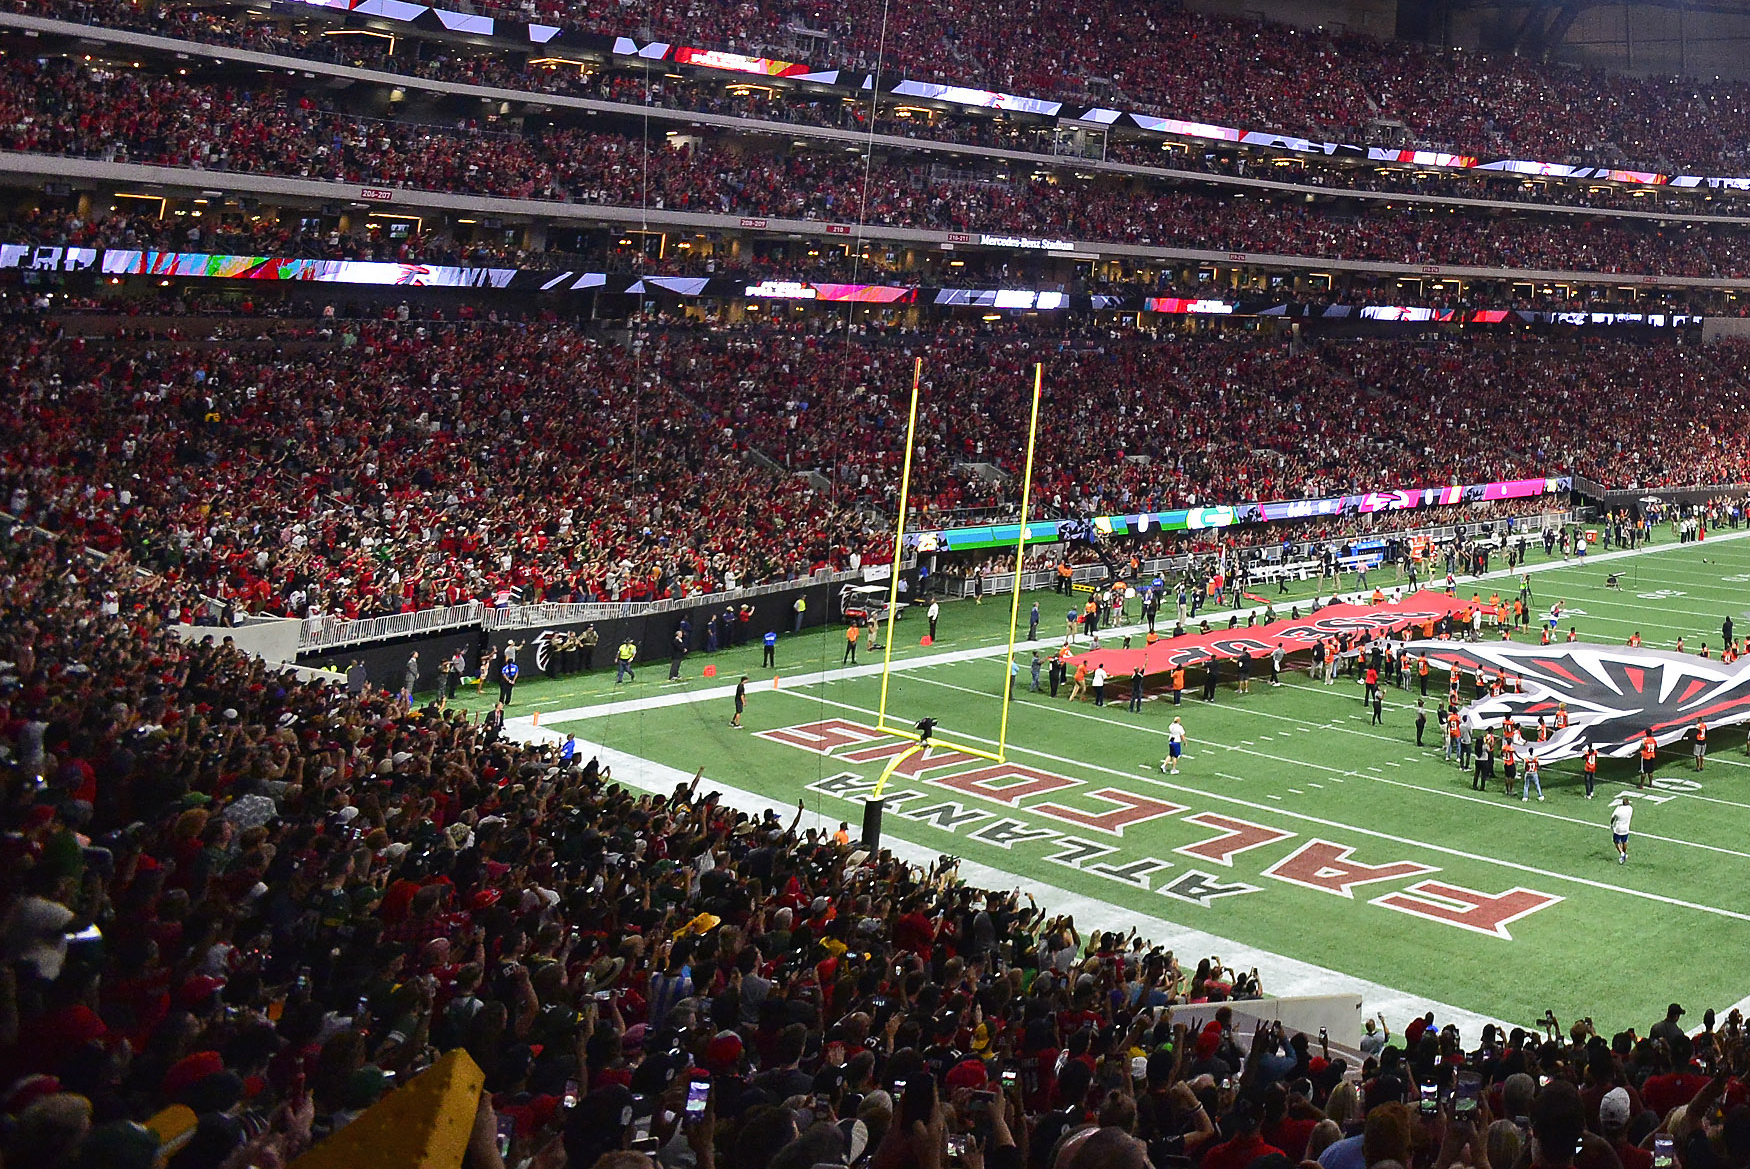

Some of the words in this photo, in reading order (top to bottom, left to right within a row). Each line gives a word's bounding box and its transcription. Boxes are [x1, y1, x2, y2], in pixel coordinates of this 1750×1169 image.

[980, 234, 1041, 249] Mercedes-Benz
[1041, 239, 1075, 250] Stadium
[751, 717, 1567, 941] FALCONS
[806, 771, 1265, 907] ATLANTA
